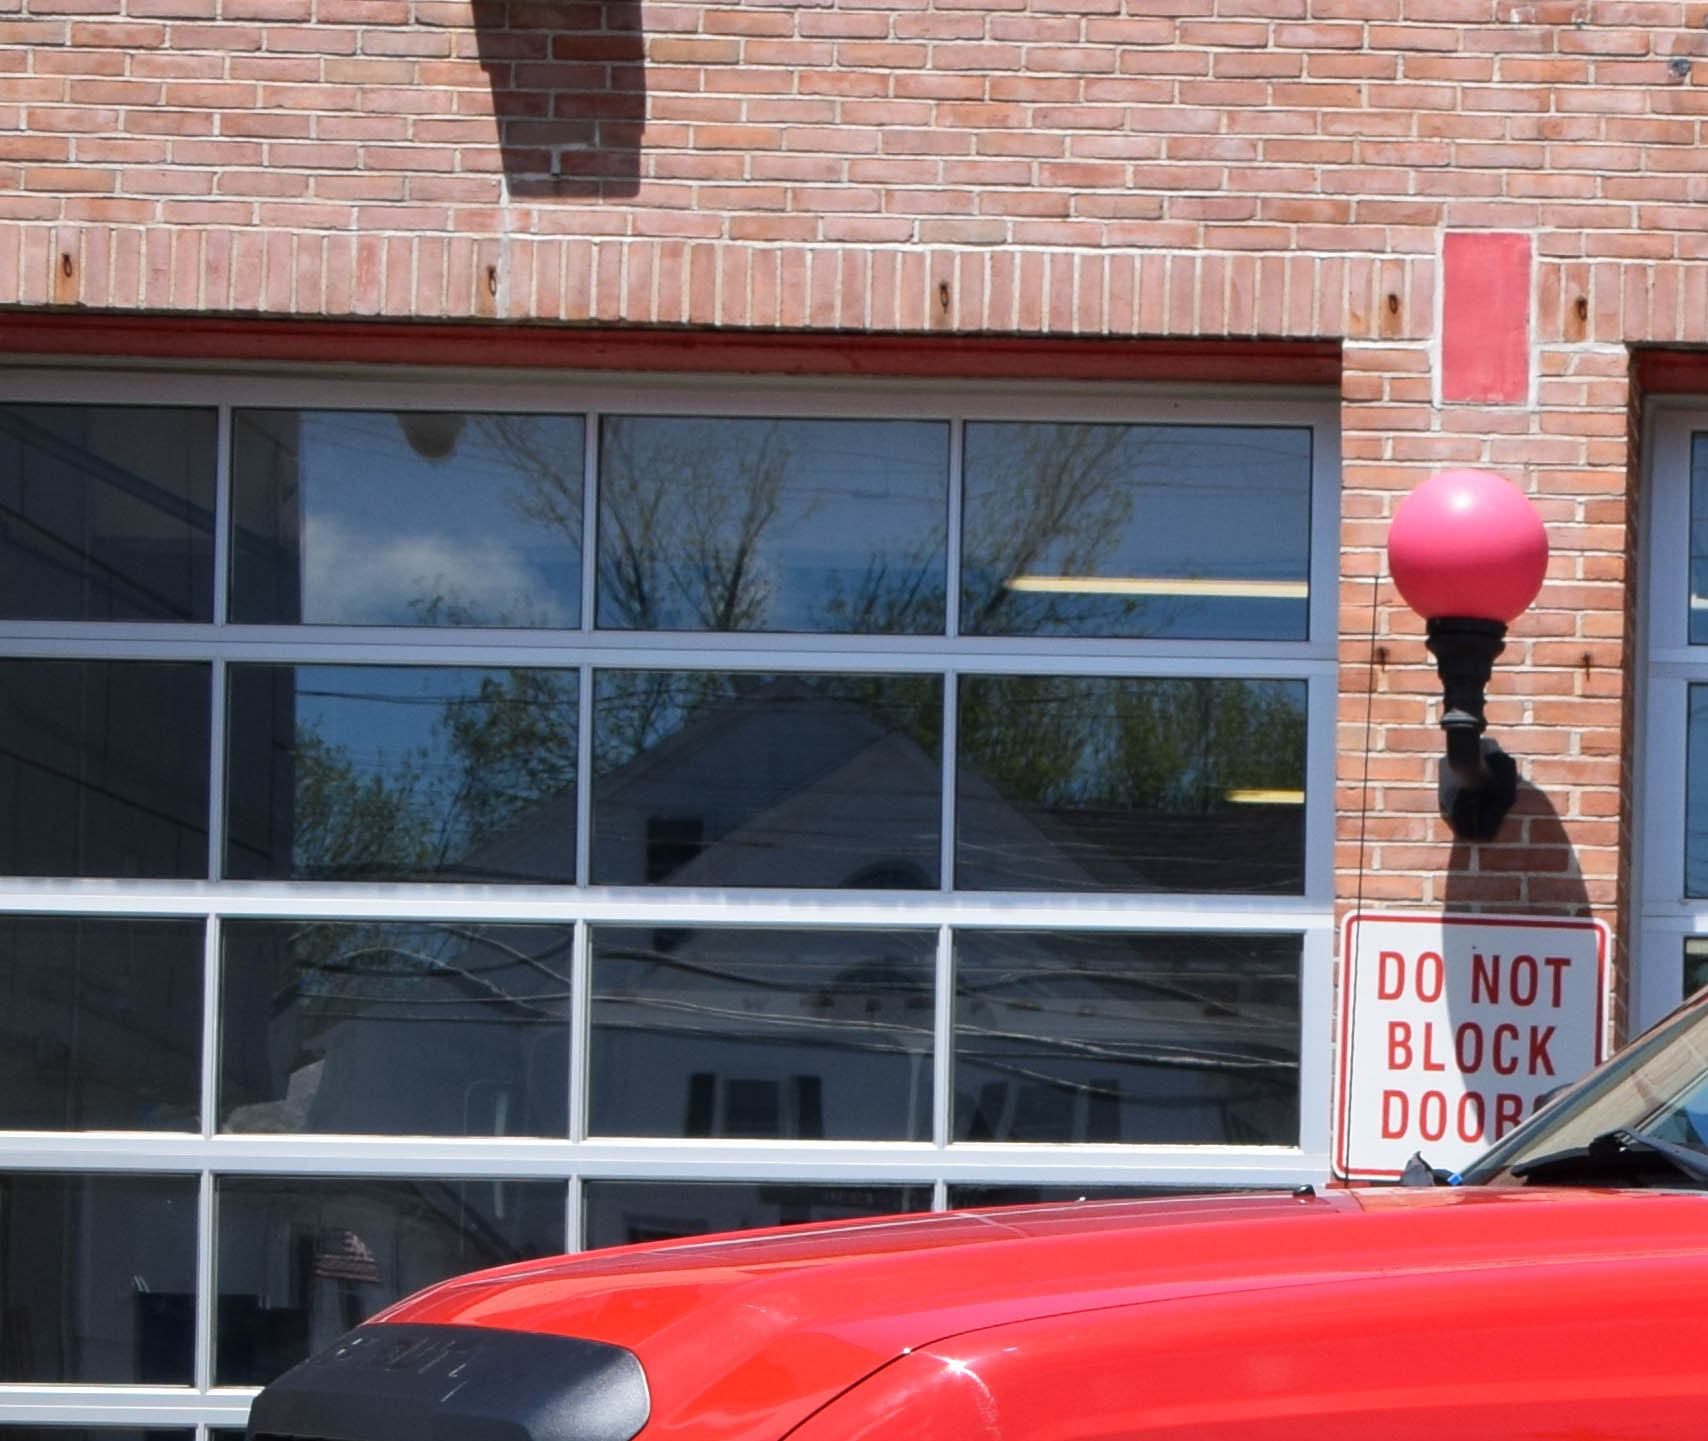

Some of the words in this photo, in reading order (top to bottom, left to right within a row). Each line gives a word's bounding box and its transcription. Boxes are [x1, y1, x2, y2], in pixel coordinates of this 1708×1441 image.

[1377, 951, 1445, 1003] DO
[1470, 953, 1572, 1008] NOT
[1387, 1020, 1557, 1076] BLOCK
